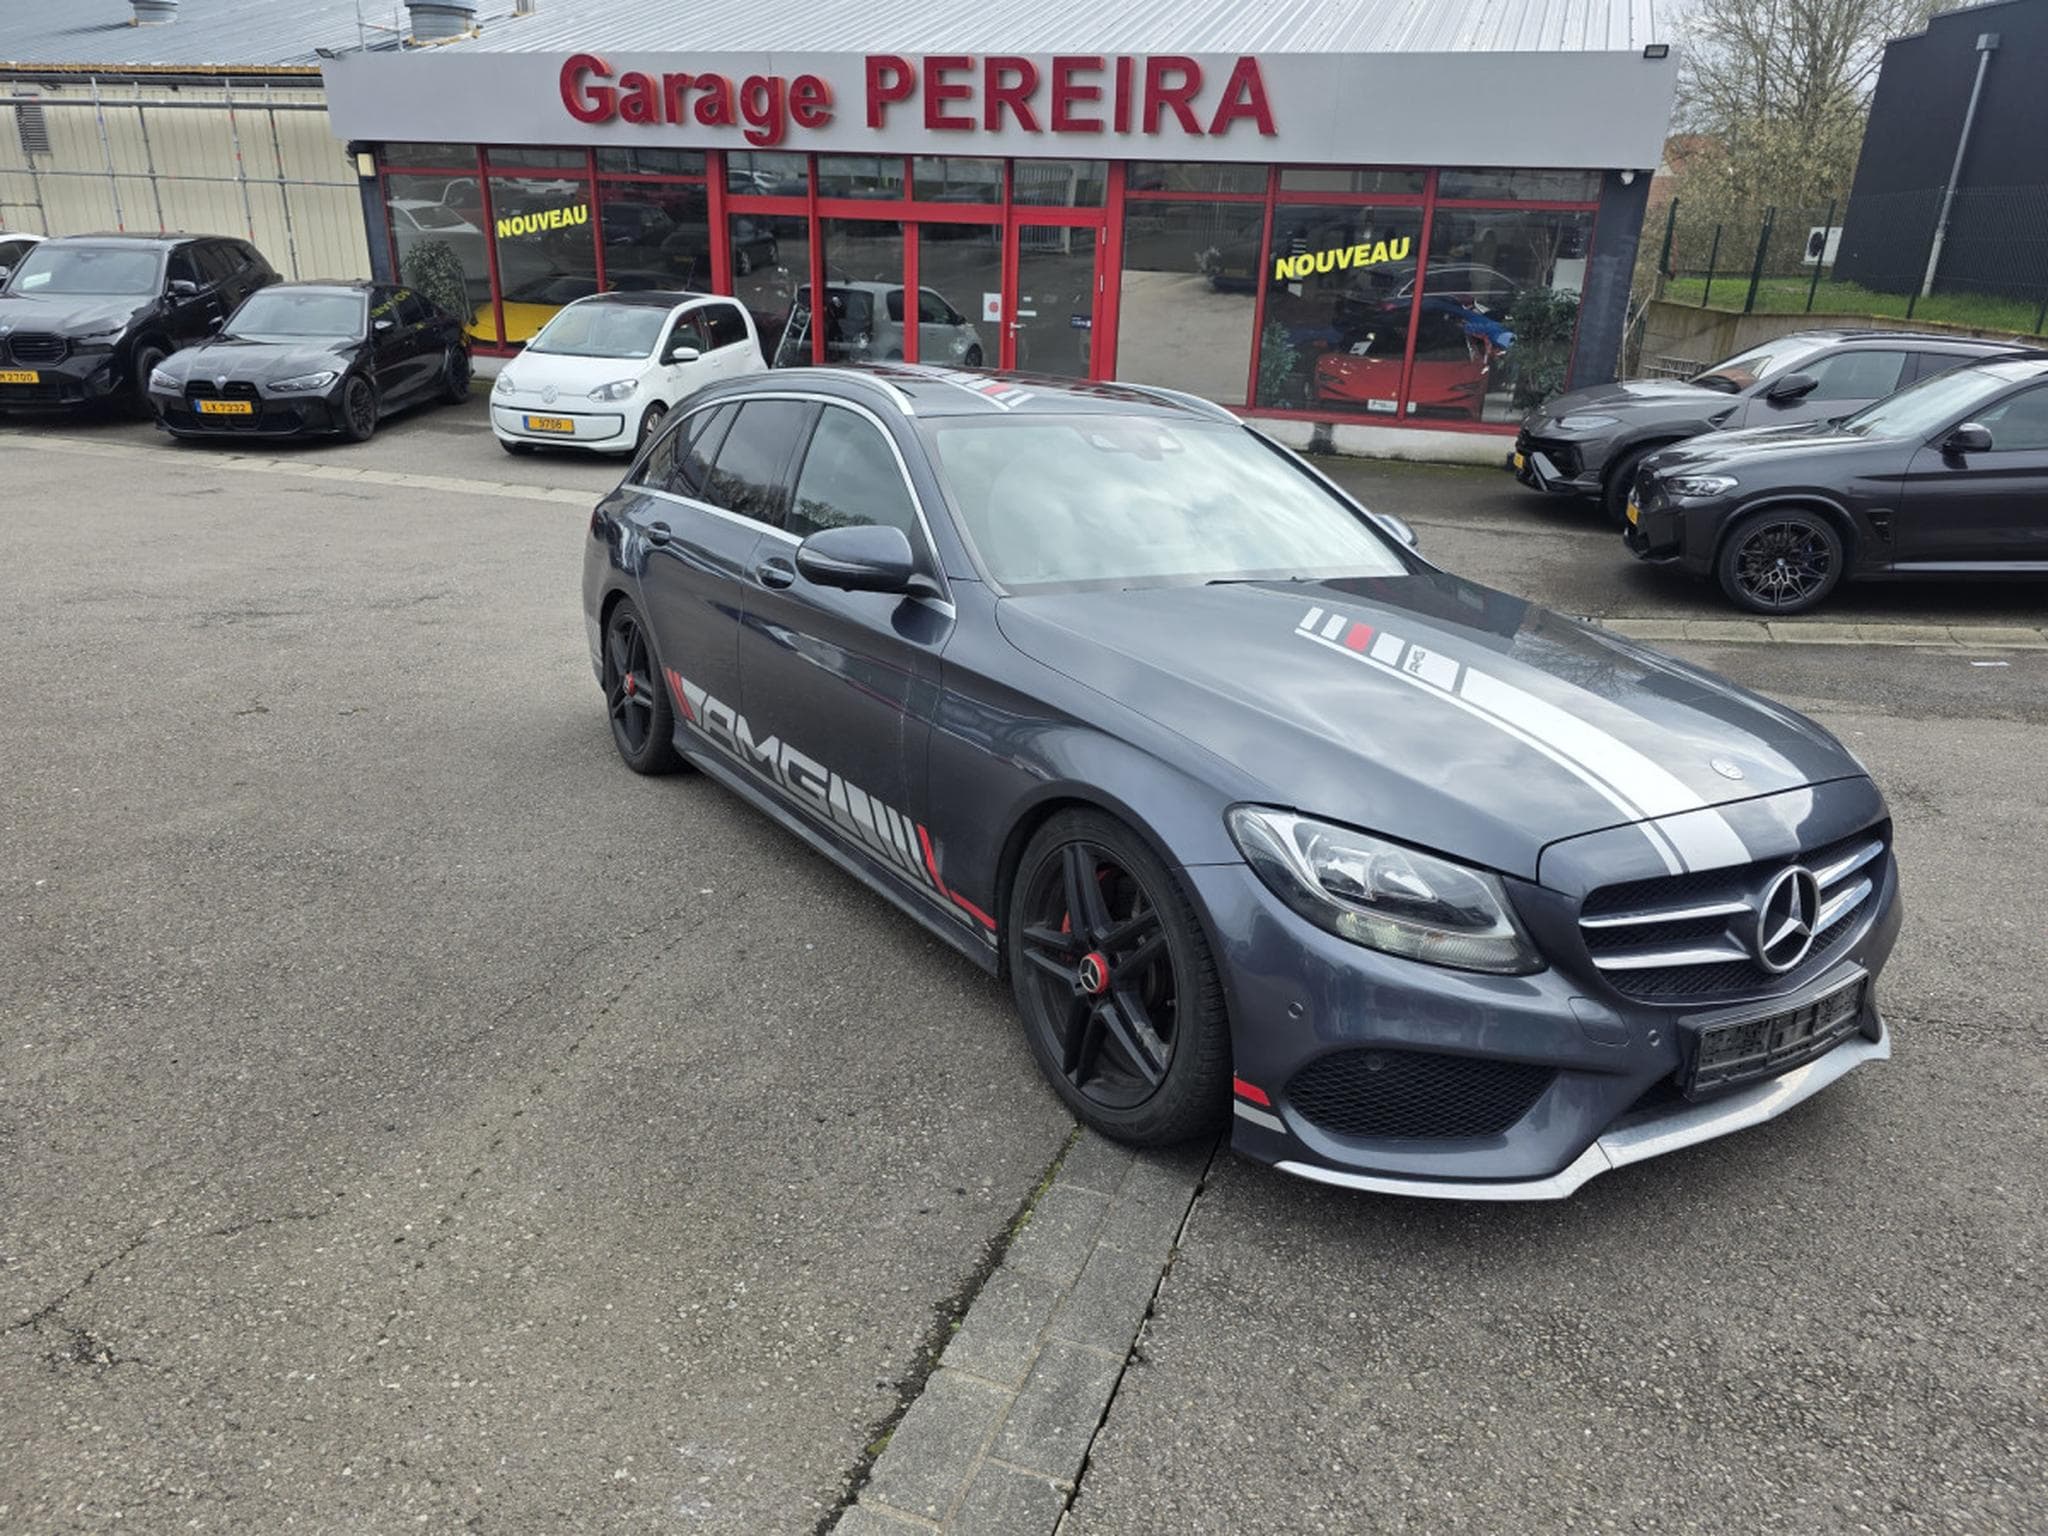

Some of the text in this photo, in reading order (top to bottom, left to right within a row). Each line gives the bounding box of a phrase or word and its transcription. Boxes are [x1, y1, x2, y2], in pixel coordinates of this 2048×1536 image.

[559, 53, 1279, 147] Garage PEREIRA
[497, 204, 588, 238] NOUVEAU
[1275, 237, 1411, 281] NOUVEAU
